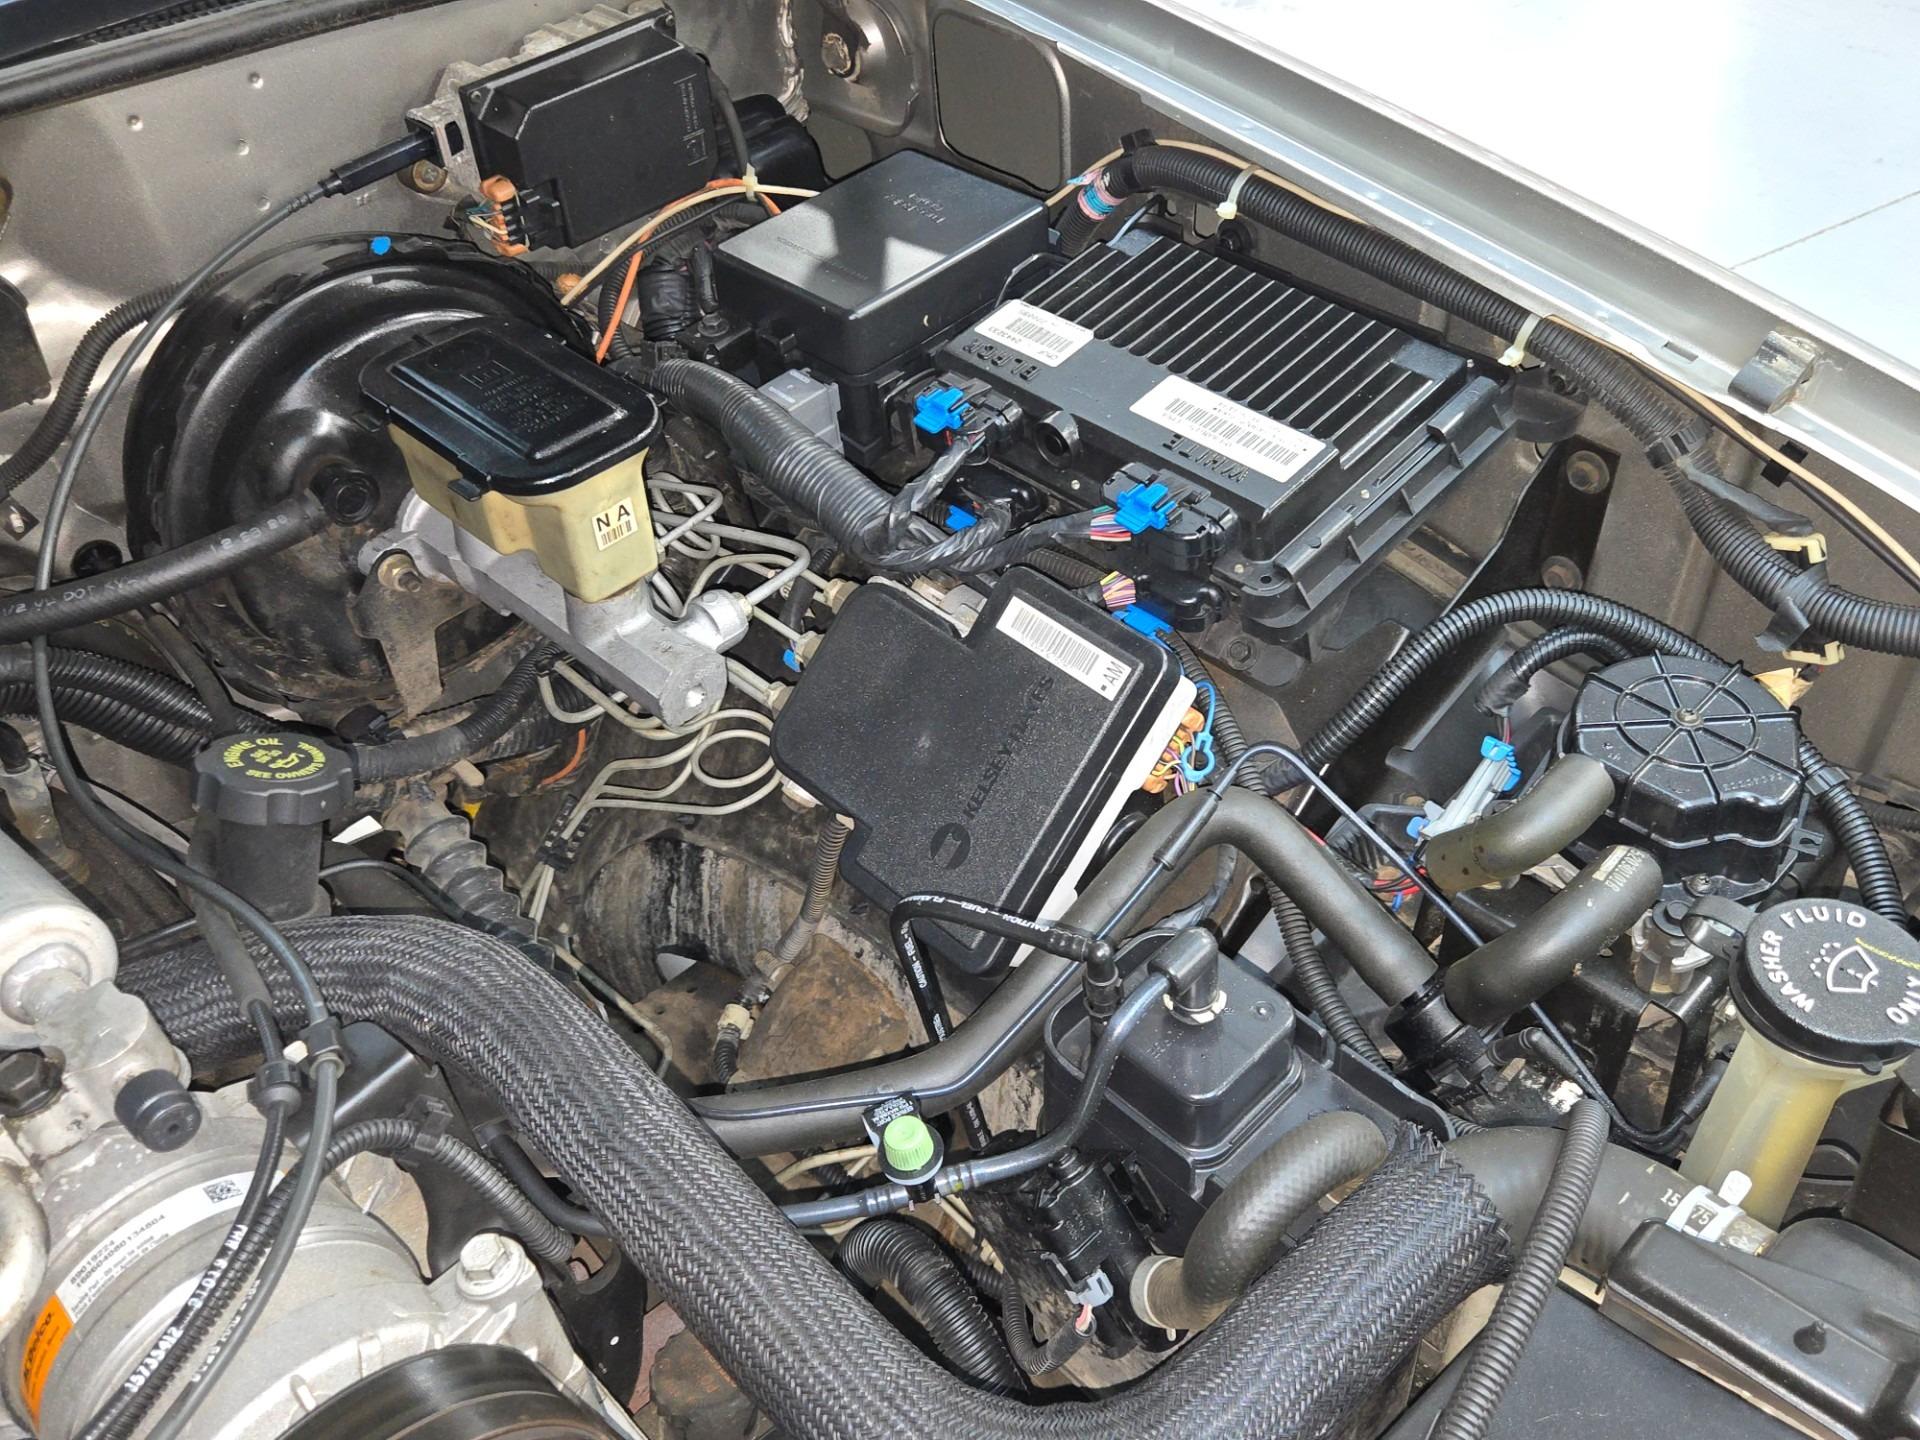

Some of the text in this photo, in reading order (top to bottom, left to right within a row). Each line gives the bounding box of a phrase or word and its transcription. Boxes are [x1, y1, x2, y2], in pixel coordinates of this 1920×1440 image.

[1100, 659, 1126, 687] AM
[223, 740, 256, 768] ENGINE
[256, 737, 284, 746] OIL
[245, 769, 272, 779] SEE
[961, 901, 989, 914] FUEL
[1780, 906, 1866, 928] FLUID
[1002, 914, 1049, 932] CAUTION
[1760, 930, 1815, 1013] WASHER
